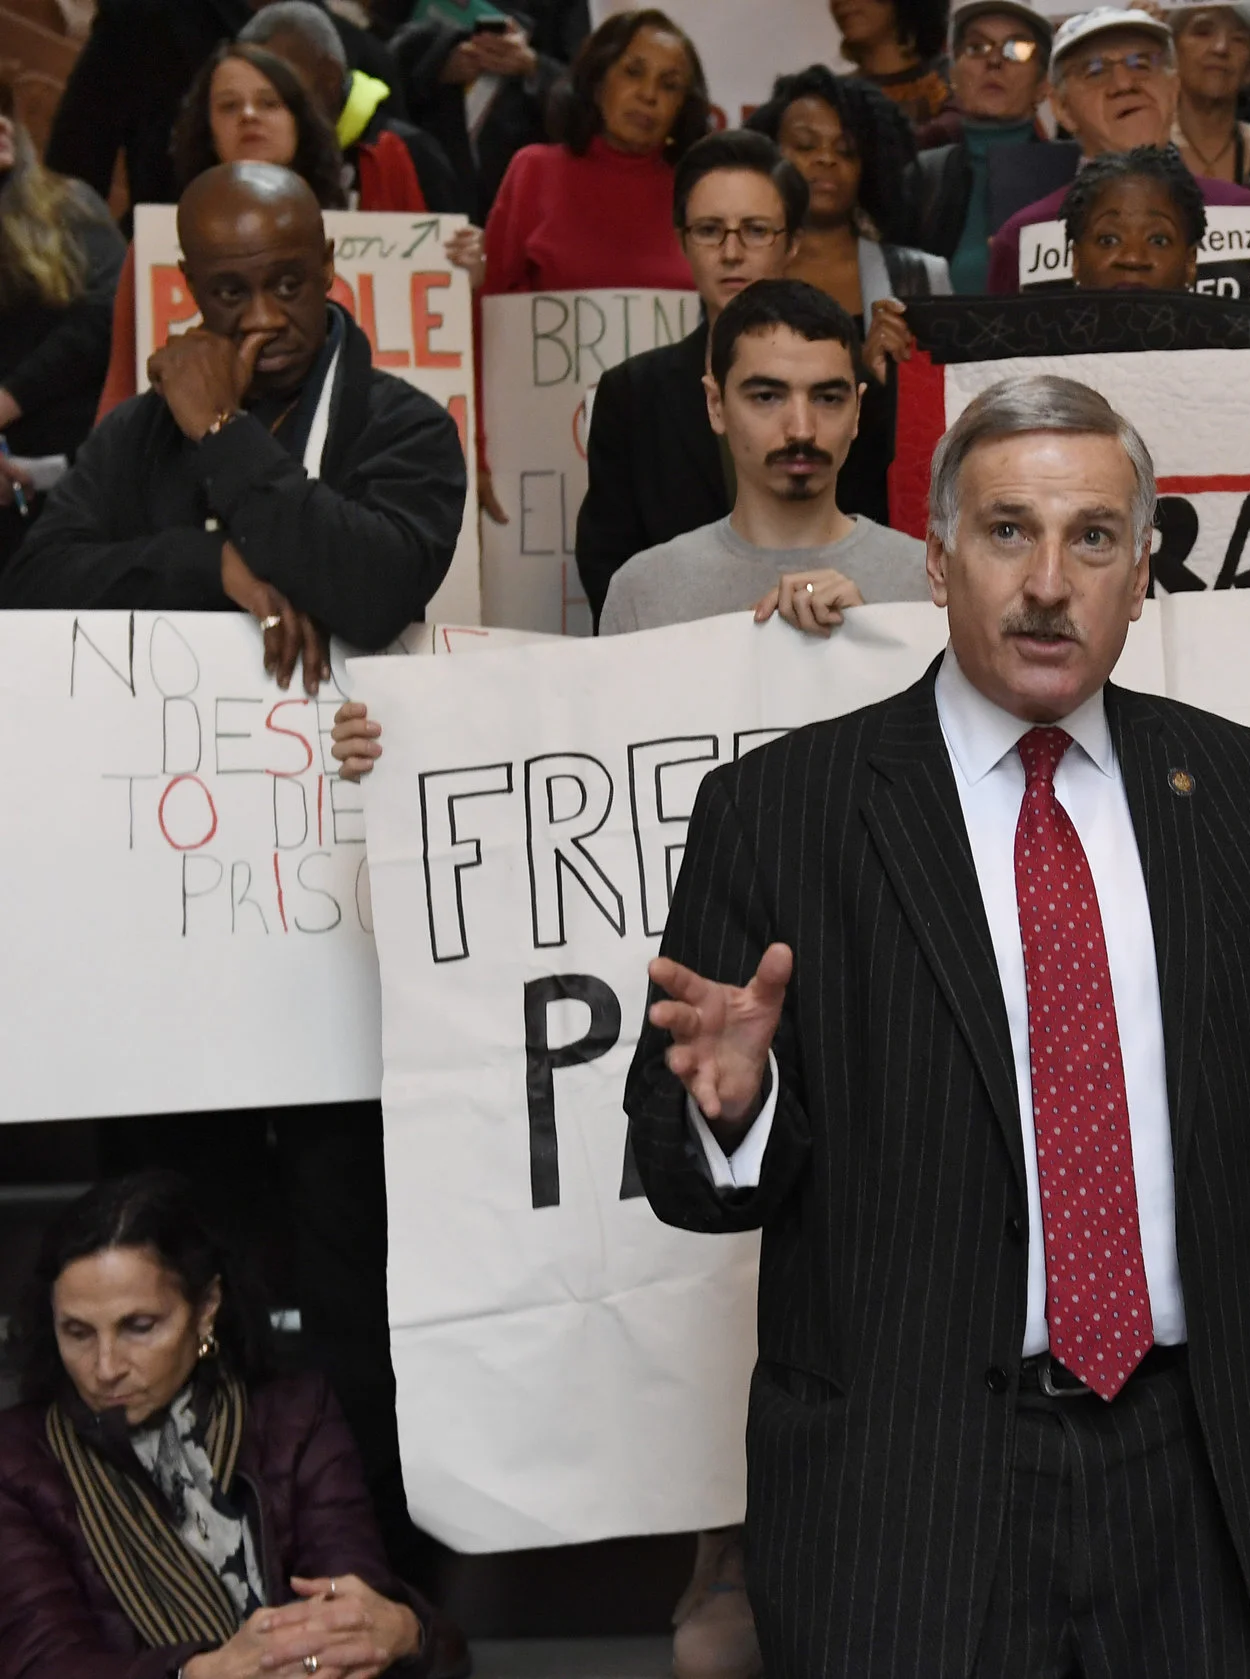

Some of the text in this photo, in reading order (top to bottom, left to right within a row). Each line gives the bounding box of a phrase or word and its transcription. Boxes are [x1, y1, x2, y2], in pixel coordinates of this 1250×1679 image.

[71, 610, 200, 698] NO
[101, 773, 367, 851] TO DIE
